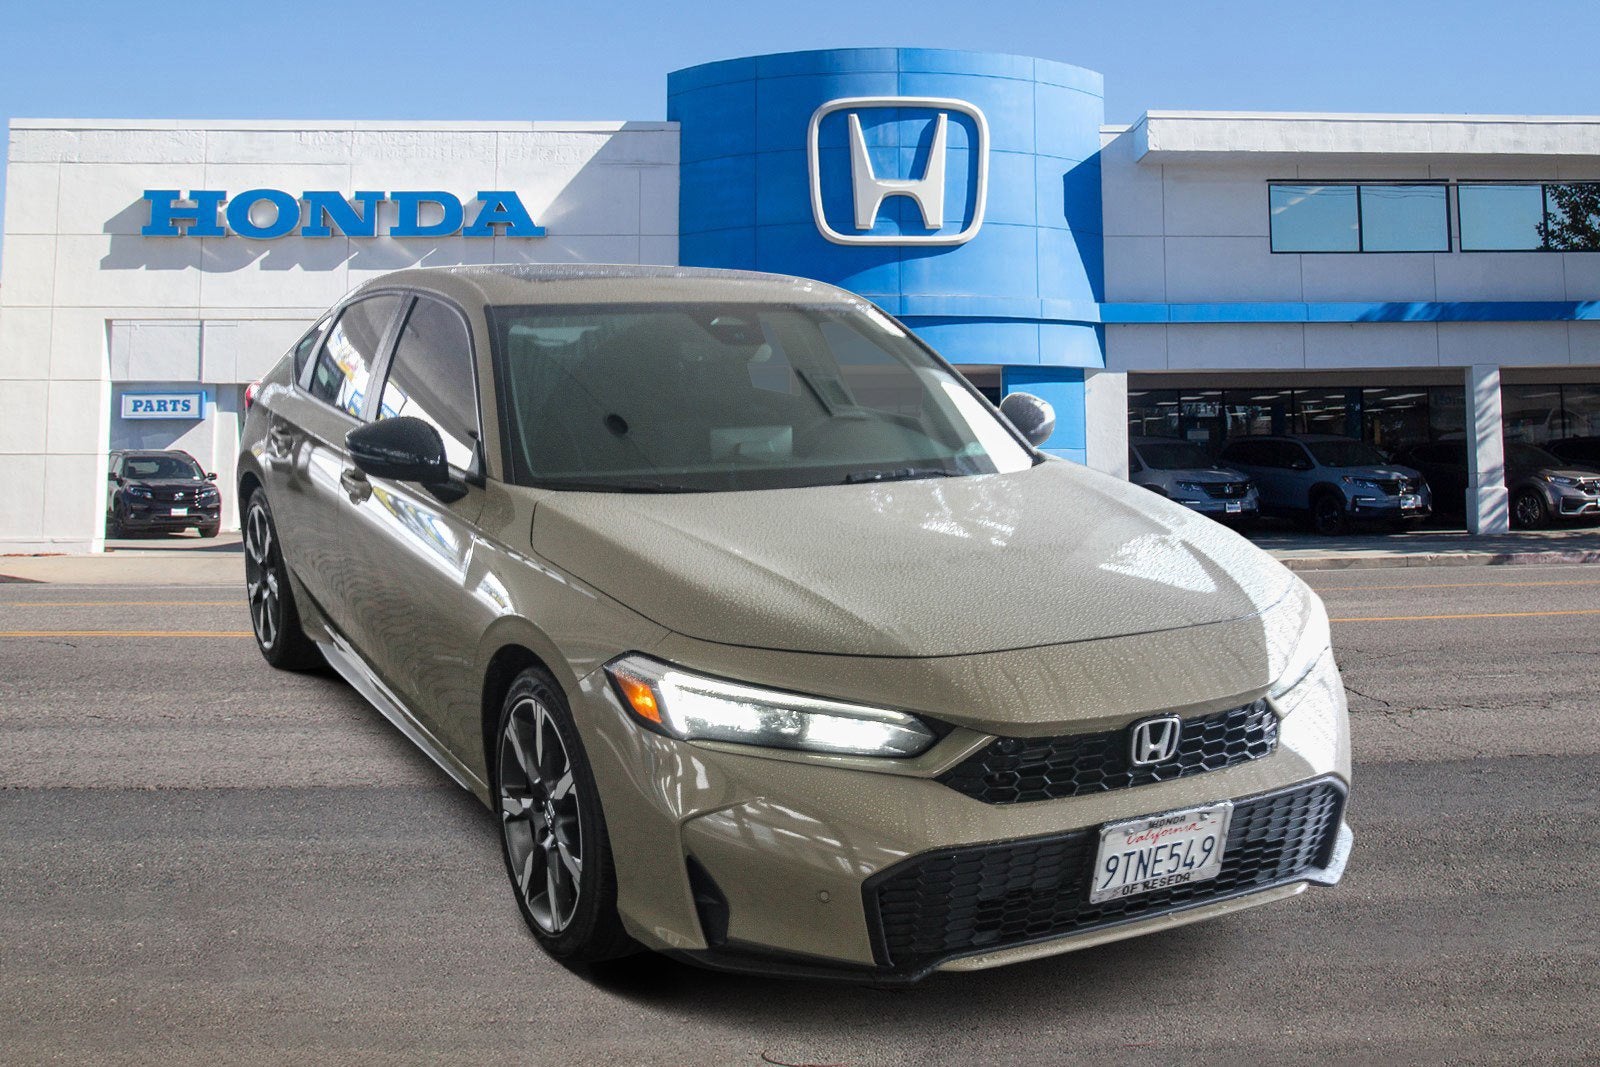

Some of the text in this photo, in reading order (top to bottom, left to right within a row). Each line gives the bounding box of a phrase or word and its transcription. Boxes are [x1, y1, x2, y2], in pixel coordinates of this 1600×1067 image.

[141, 188, 547, 239] HONDA
[131, 399, 191, 412] PARTS
[1102, 836, 1215, 888] 9TNE549
[1122, 873, 1190, 894] OF RESEDA
